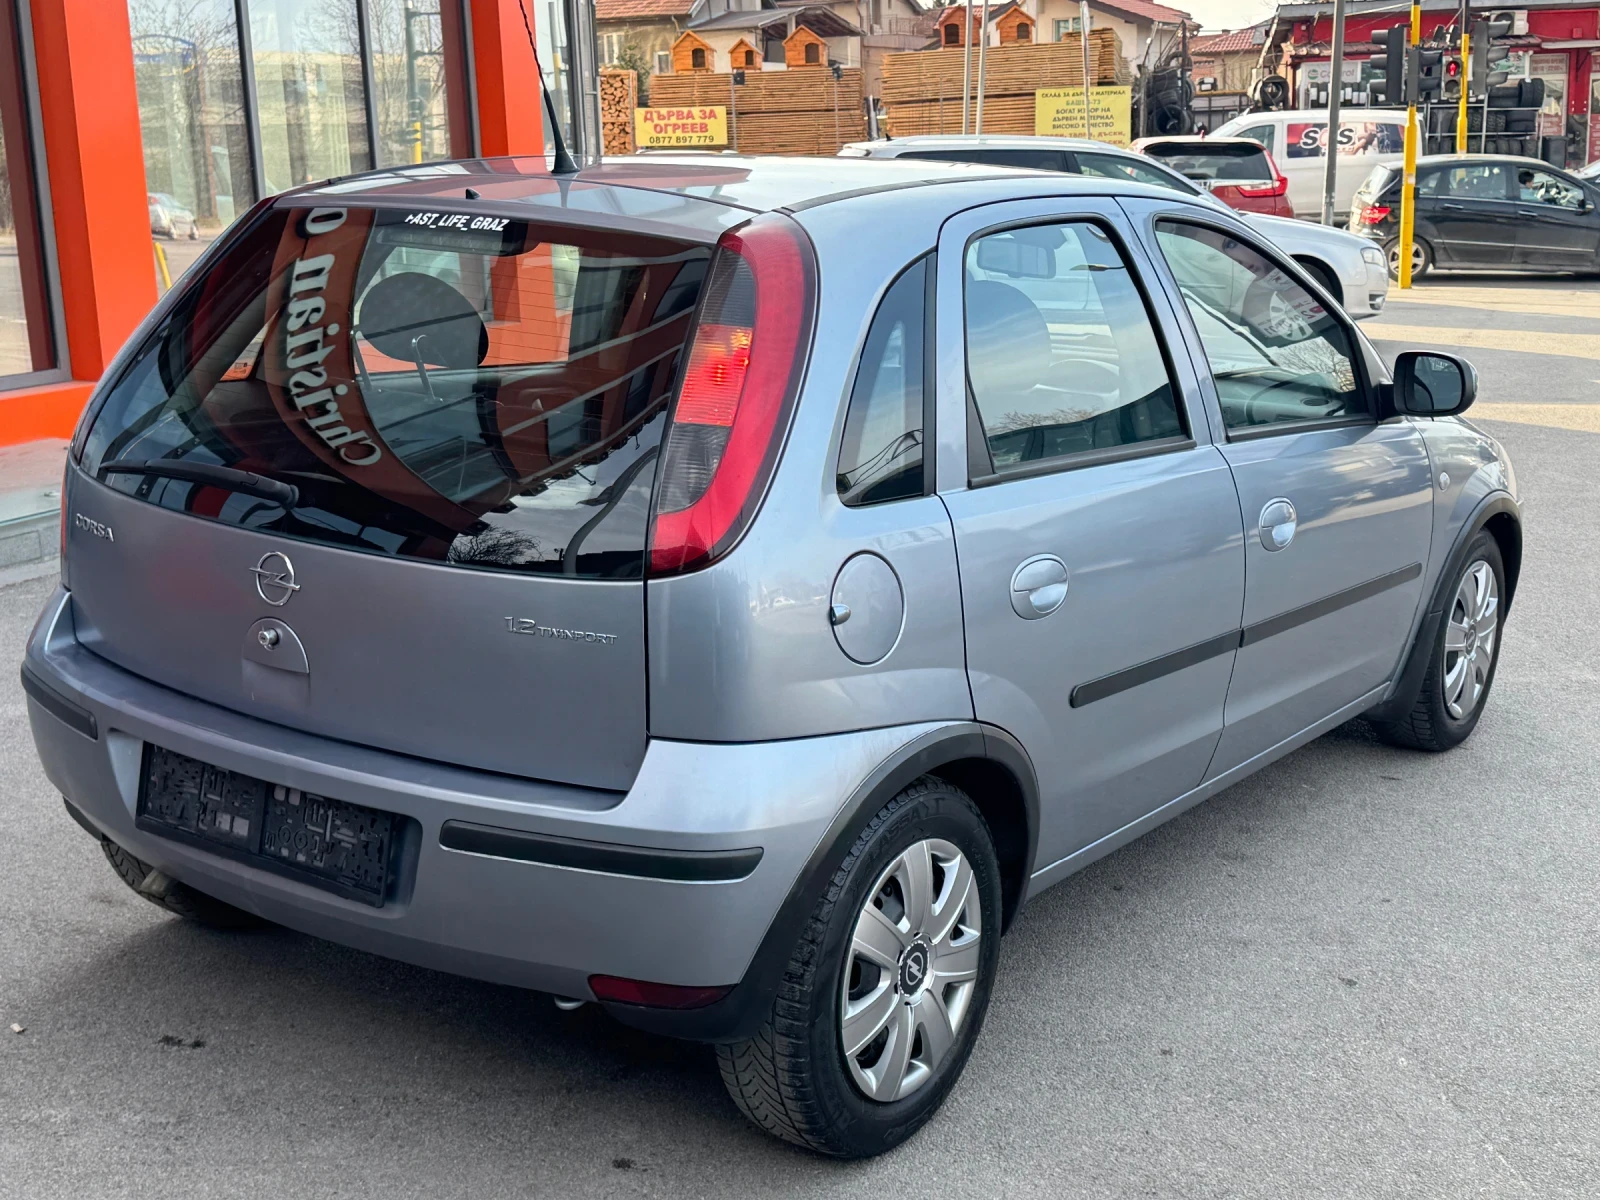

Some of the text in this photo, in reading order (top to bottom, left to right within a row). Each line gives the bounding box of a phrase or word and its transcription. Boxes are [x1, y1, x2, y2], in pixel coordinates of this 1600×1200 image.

[1320, 69, 1355, 78] Crol
[643, 108, 718, 123] ДЪРВА ЗА
[653, 122, 709, 134] ОГРЕЕВ
[649, 135, 714, 144] 0877 897 779
[75, 512, 115, 542] CORSA
[537, 626, 618, 645] TWINPORT
